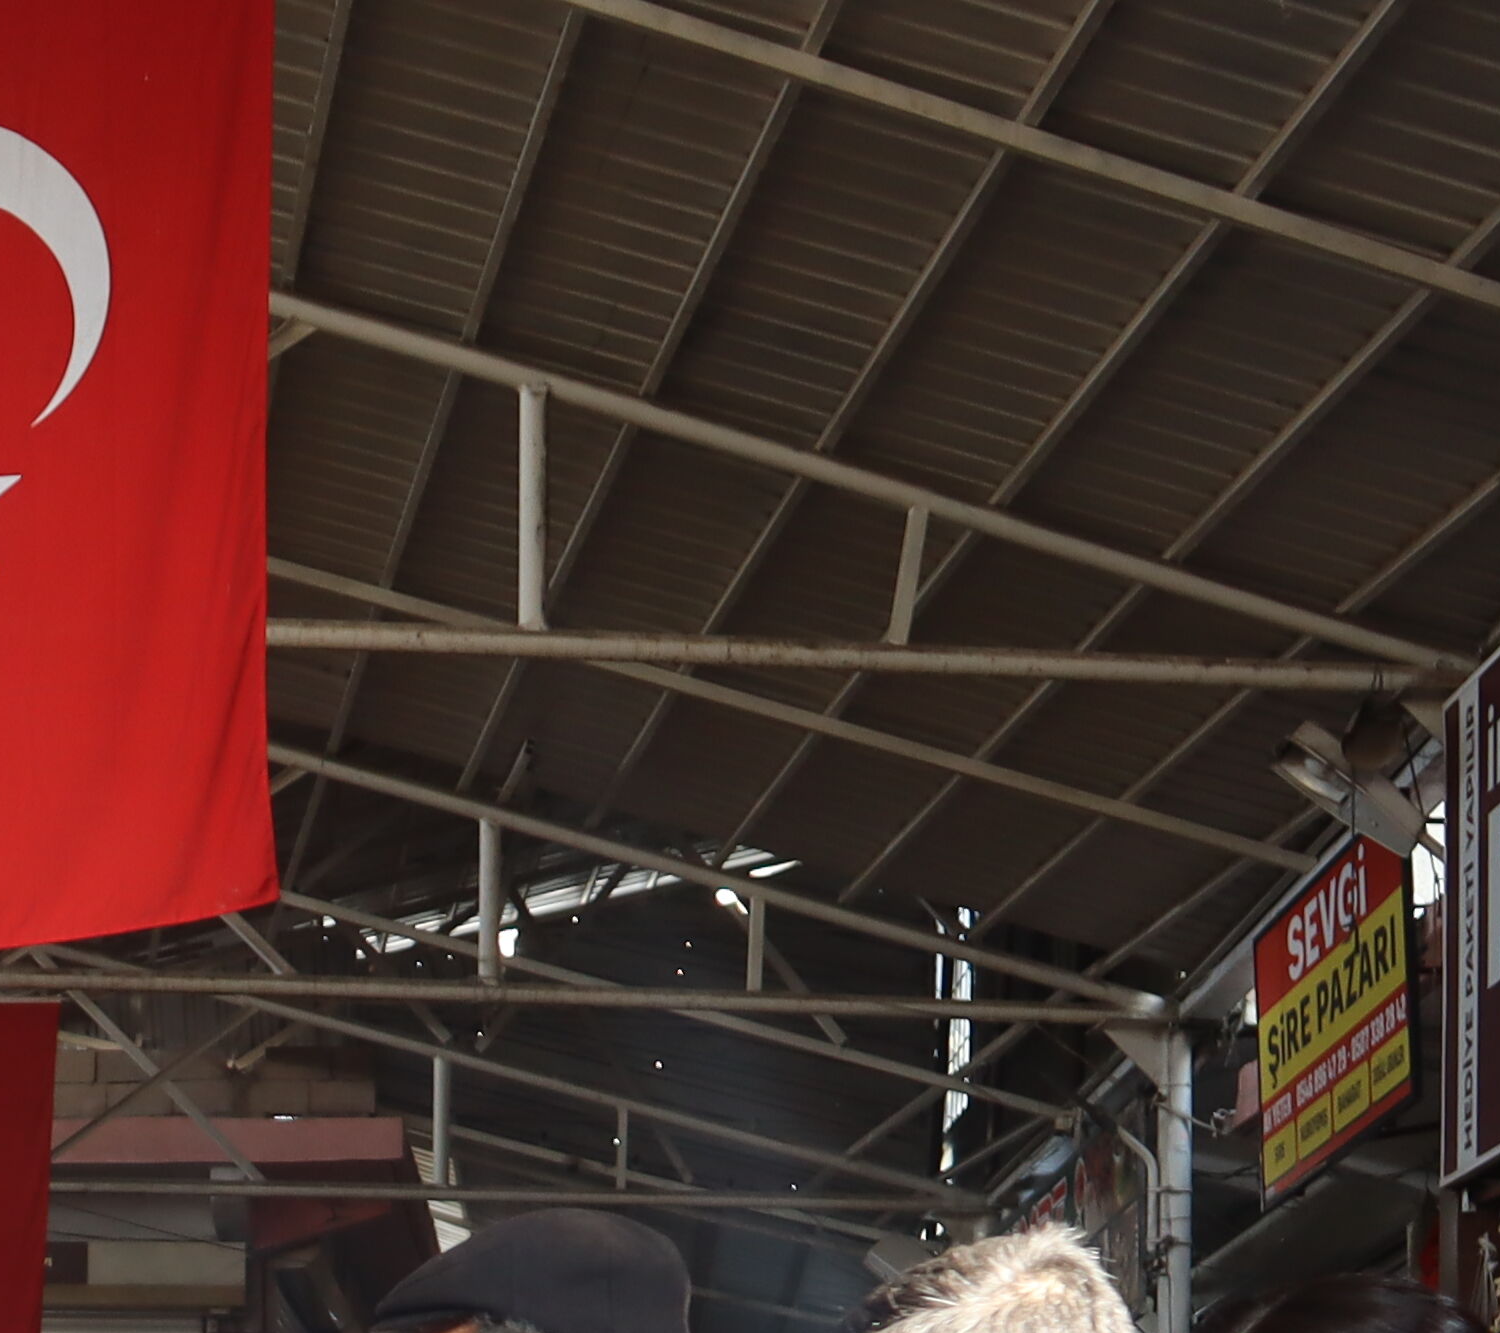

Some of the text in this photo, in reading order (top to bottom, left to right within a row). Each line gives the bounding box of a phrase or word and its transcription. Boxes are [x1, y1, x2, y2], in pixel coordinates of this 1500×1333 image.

[1287, 843, 1367, 981] SEVGİ
[1463, 862, 1475, 997] PAKETİ
[1268, 995, 1311, 1089] ŞİRE
[1317, 914, 1396, 1033] PAZARI
[1463, 1008, 1475, 1149] HEDİYE
